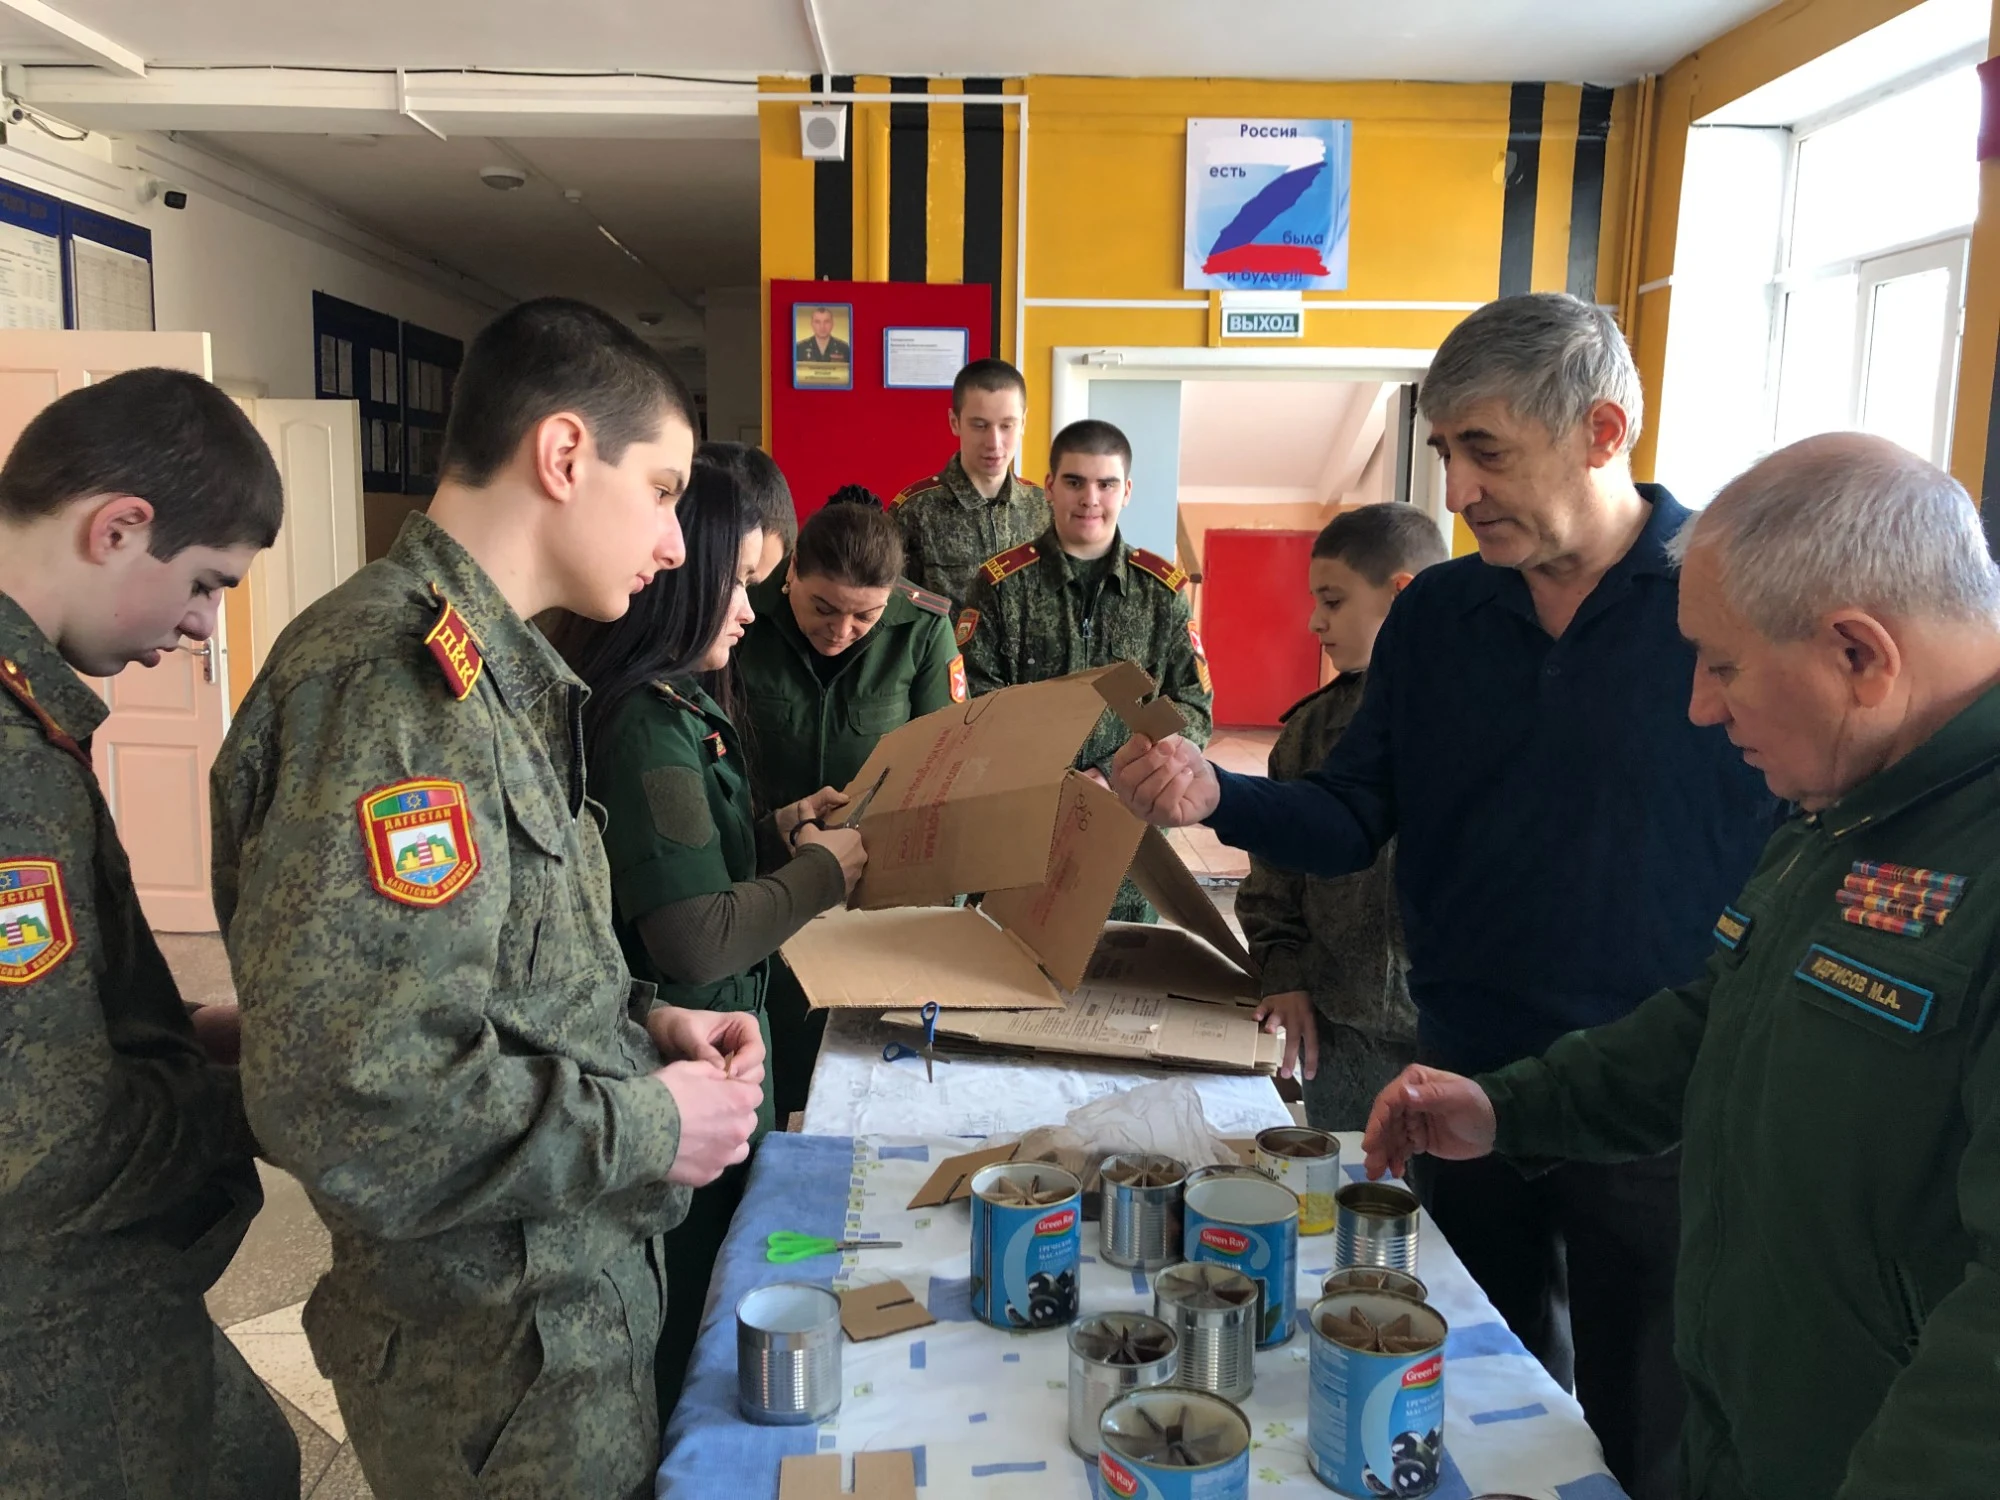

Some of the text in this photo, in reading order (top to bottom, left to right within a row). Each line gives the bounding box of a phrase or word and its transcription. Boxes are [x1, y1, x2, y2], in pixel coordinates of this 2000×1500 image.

[1240, 124, 1298, 138] Россия
[1209, 165, 1246, 178] есть
[1282, 230, 1324, 245] была
[1227, 271, 1236, 282] и
[1229, 314, 1296, 332] ВЫХОД
[384, 808, 451, 831] ДАГЕСТАН
[0, 887, 45, 905] ЕСТАН
[386, 876, 439, 898] КАДЕТСКИЙ
[1811, 957, 1902, 1010] ИДРИСОВ М.А.
[1038, 1218, 1063, 1230] Green
[1202, 1230, 1246, 1250] Green Ray
[1406, 1368, 1432, 1382] Green
[1116, 1470, 1134, 1491] Ray
